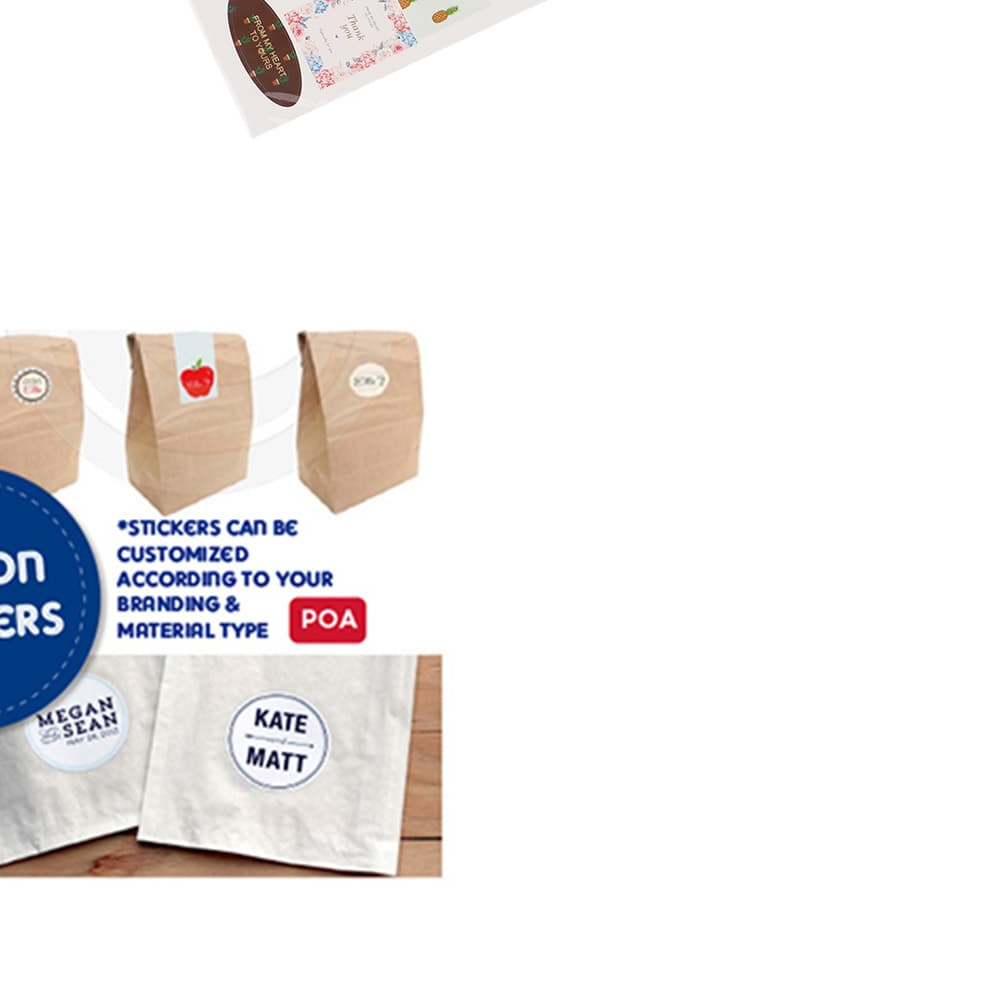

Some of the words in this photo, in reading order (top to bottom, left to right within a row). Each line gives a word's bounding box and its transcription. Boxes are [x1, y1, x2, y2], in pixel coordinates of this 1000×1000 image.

[347, 13, 366, 41] Thank
[249, 29, 260, 42] TO
[255, 41, 273, 70] YOURS
[252, 14, 268, 39] FROM
[269, 50, 288, 77] HEART
[36, 696, 114, 728] MEGAN
[63, 711, 118, 738] SEAN
[254, 708, 309, 735] KATE
[246, 745, 308, 773] MATT
